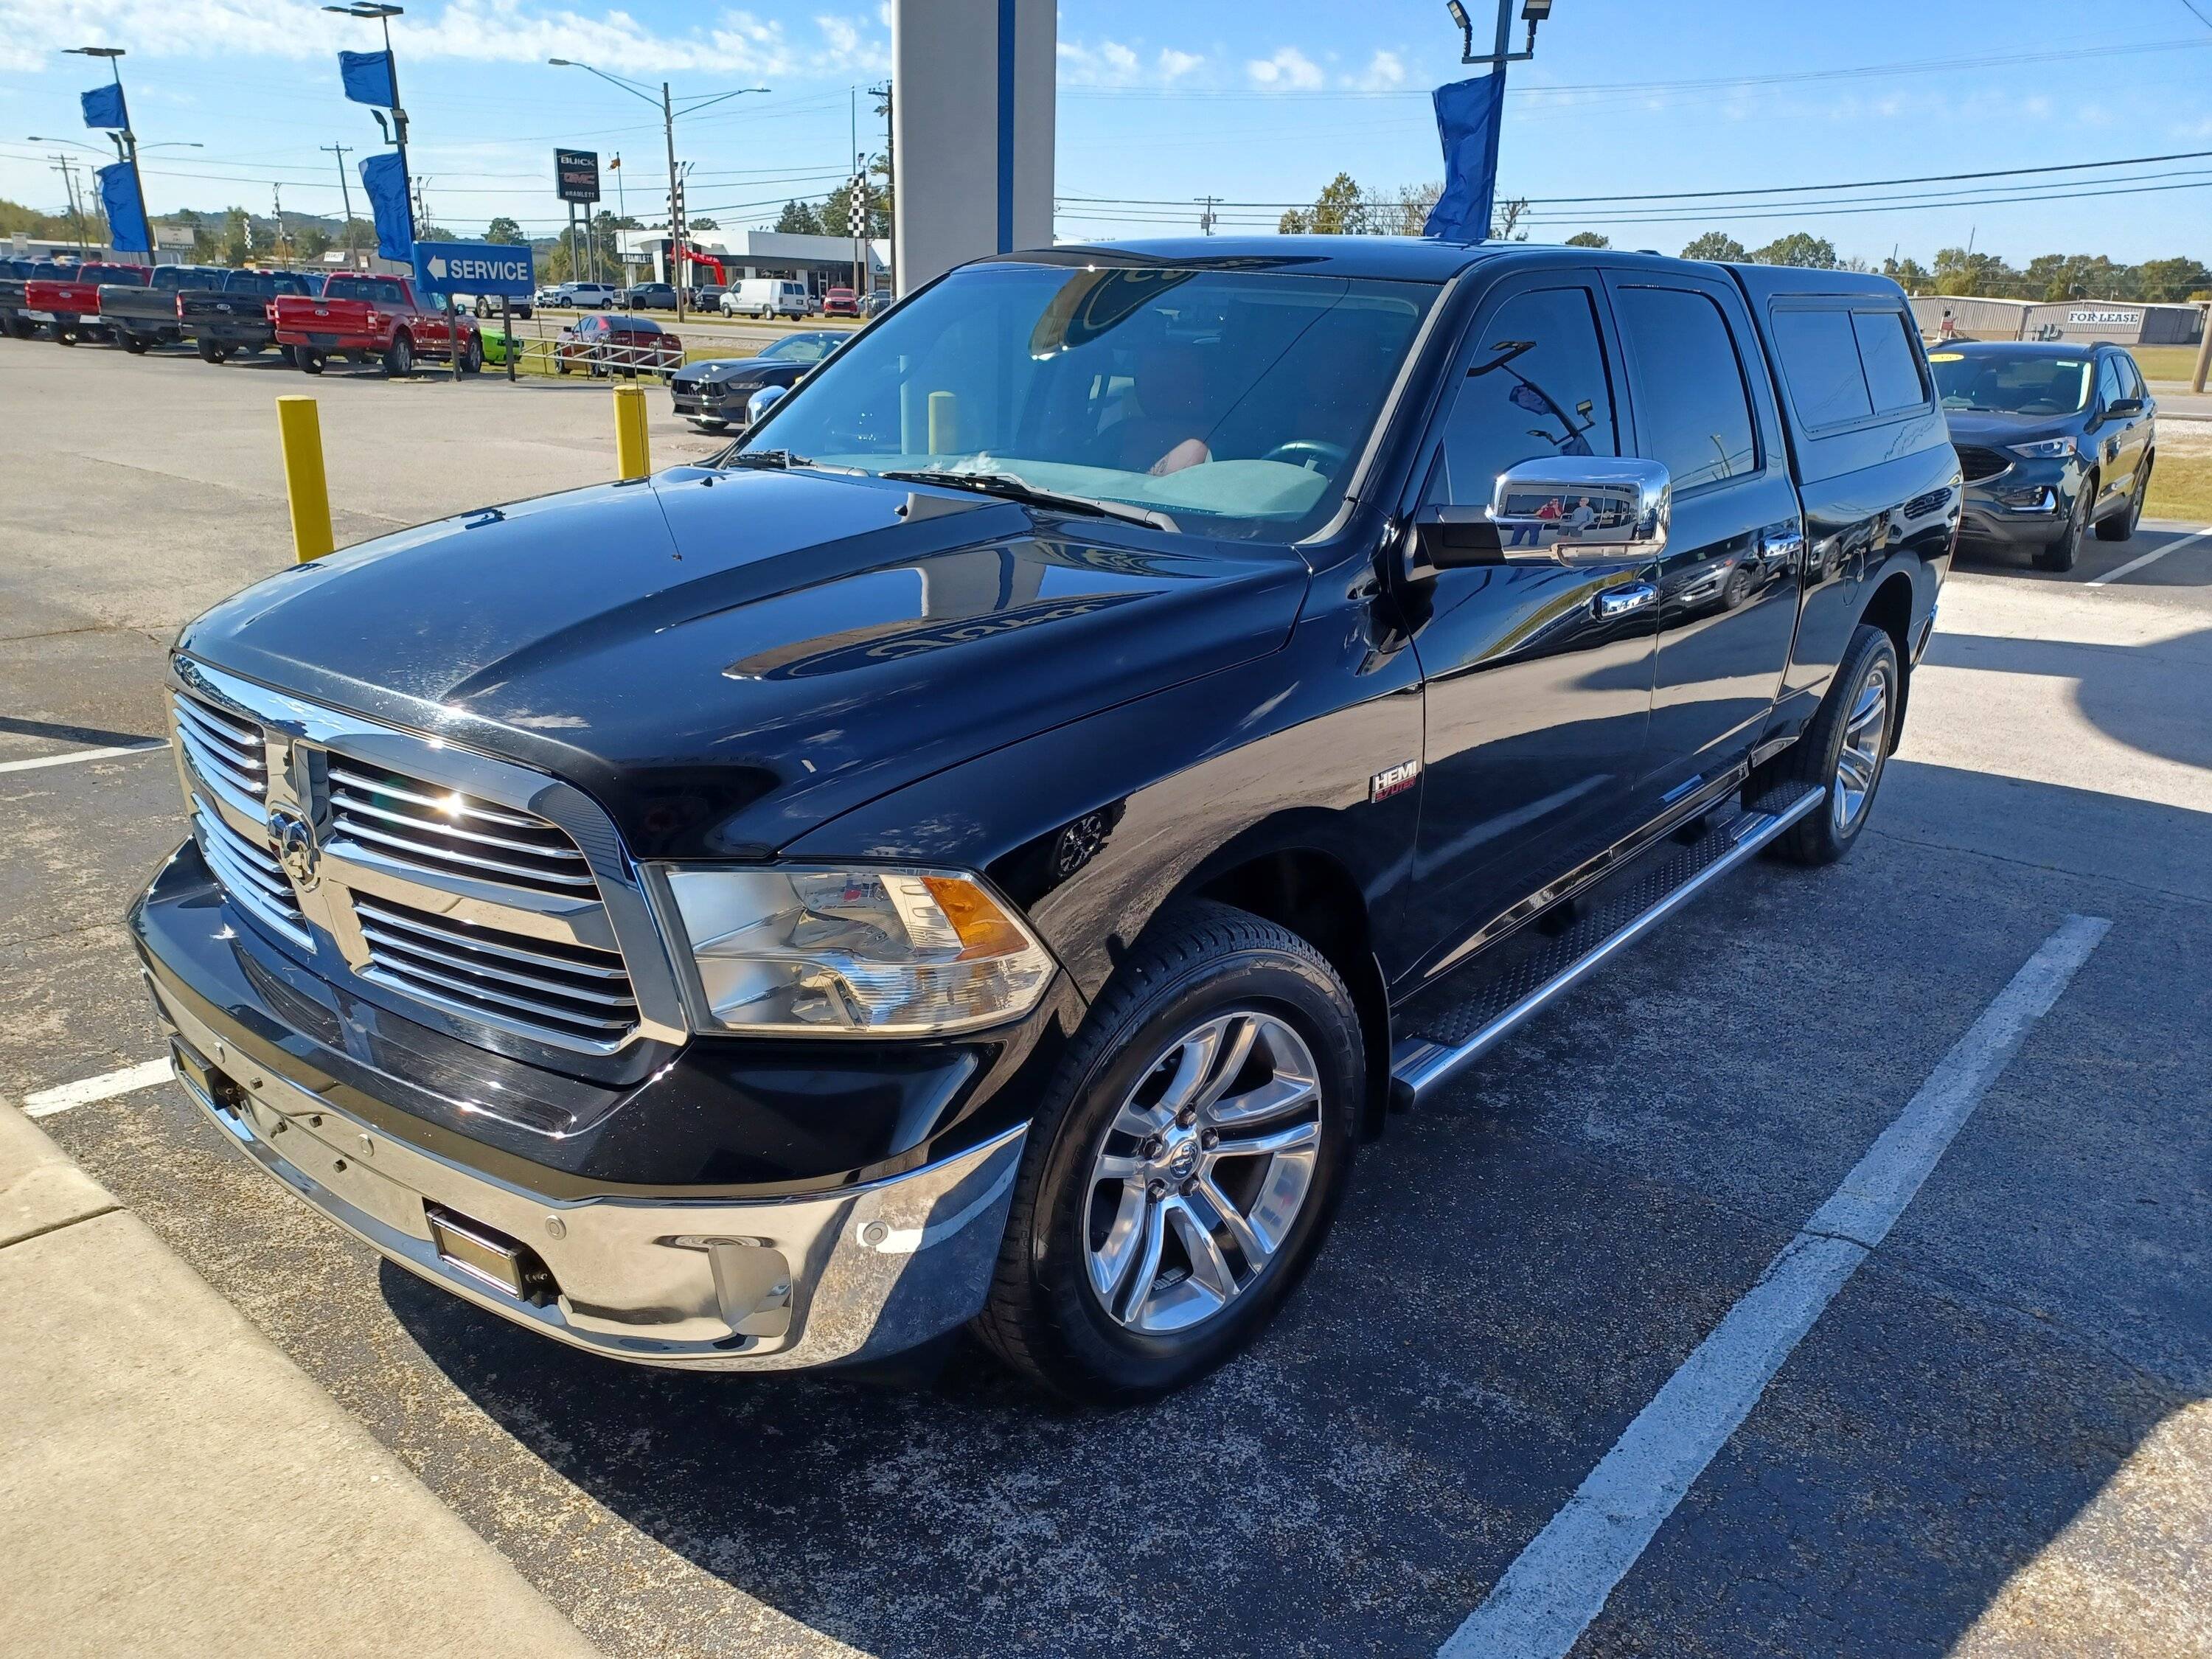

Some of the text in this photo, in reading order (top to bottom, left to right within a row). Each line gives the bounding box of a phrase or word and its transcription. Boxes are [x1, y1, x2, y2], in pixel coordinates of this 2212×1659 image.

[561, 157, 595, 167] BUICK
[564, 173, 595, 185] GMC
[565, 190, 595, 198] BRAMLETT
[451, 260, 529, 281] SERVICE
[2069, 313, 2138, 322] FOR LEASE
[1374, 759, 1417, 792] HEMI
